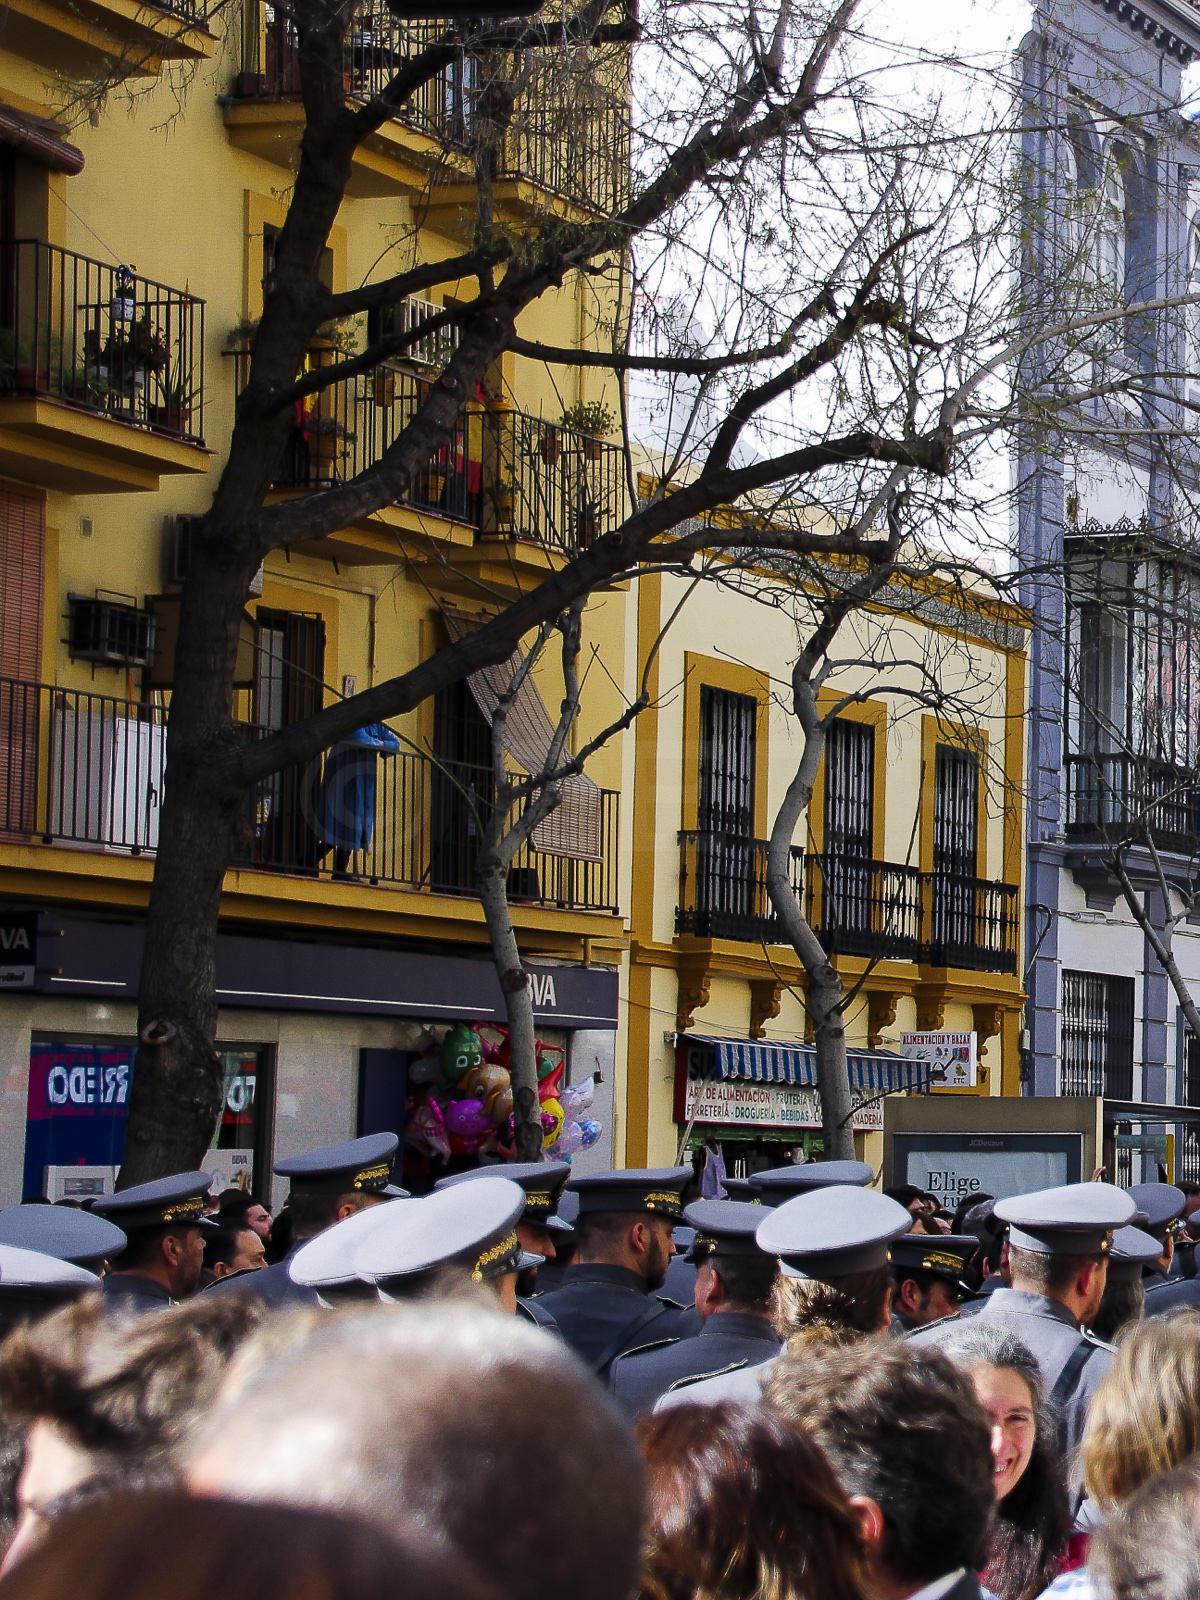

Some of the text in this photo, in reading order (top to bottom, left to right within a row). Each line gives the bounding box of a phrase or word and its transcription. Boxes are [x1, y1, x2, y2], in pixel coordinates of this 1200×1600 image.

[0, 927, 30, 950] VA
[526, 973, 557, 1007] BVA
[903, 1034, 945, 1045] ALIMENTACION
[946, 1034, 951, 1045] Y
[706, 1088, 717, 1100] DE
[718, 1088, 770, 1103] ALIMENTACIÓN
[735, 1106, 775, 1120] DROGUERÍA
[781, 1109, 809, 1122] BEBIDAS
[851, 1113, 882, 1125] ANADERÍA
[926, 1171, 980, 1195] Elige
